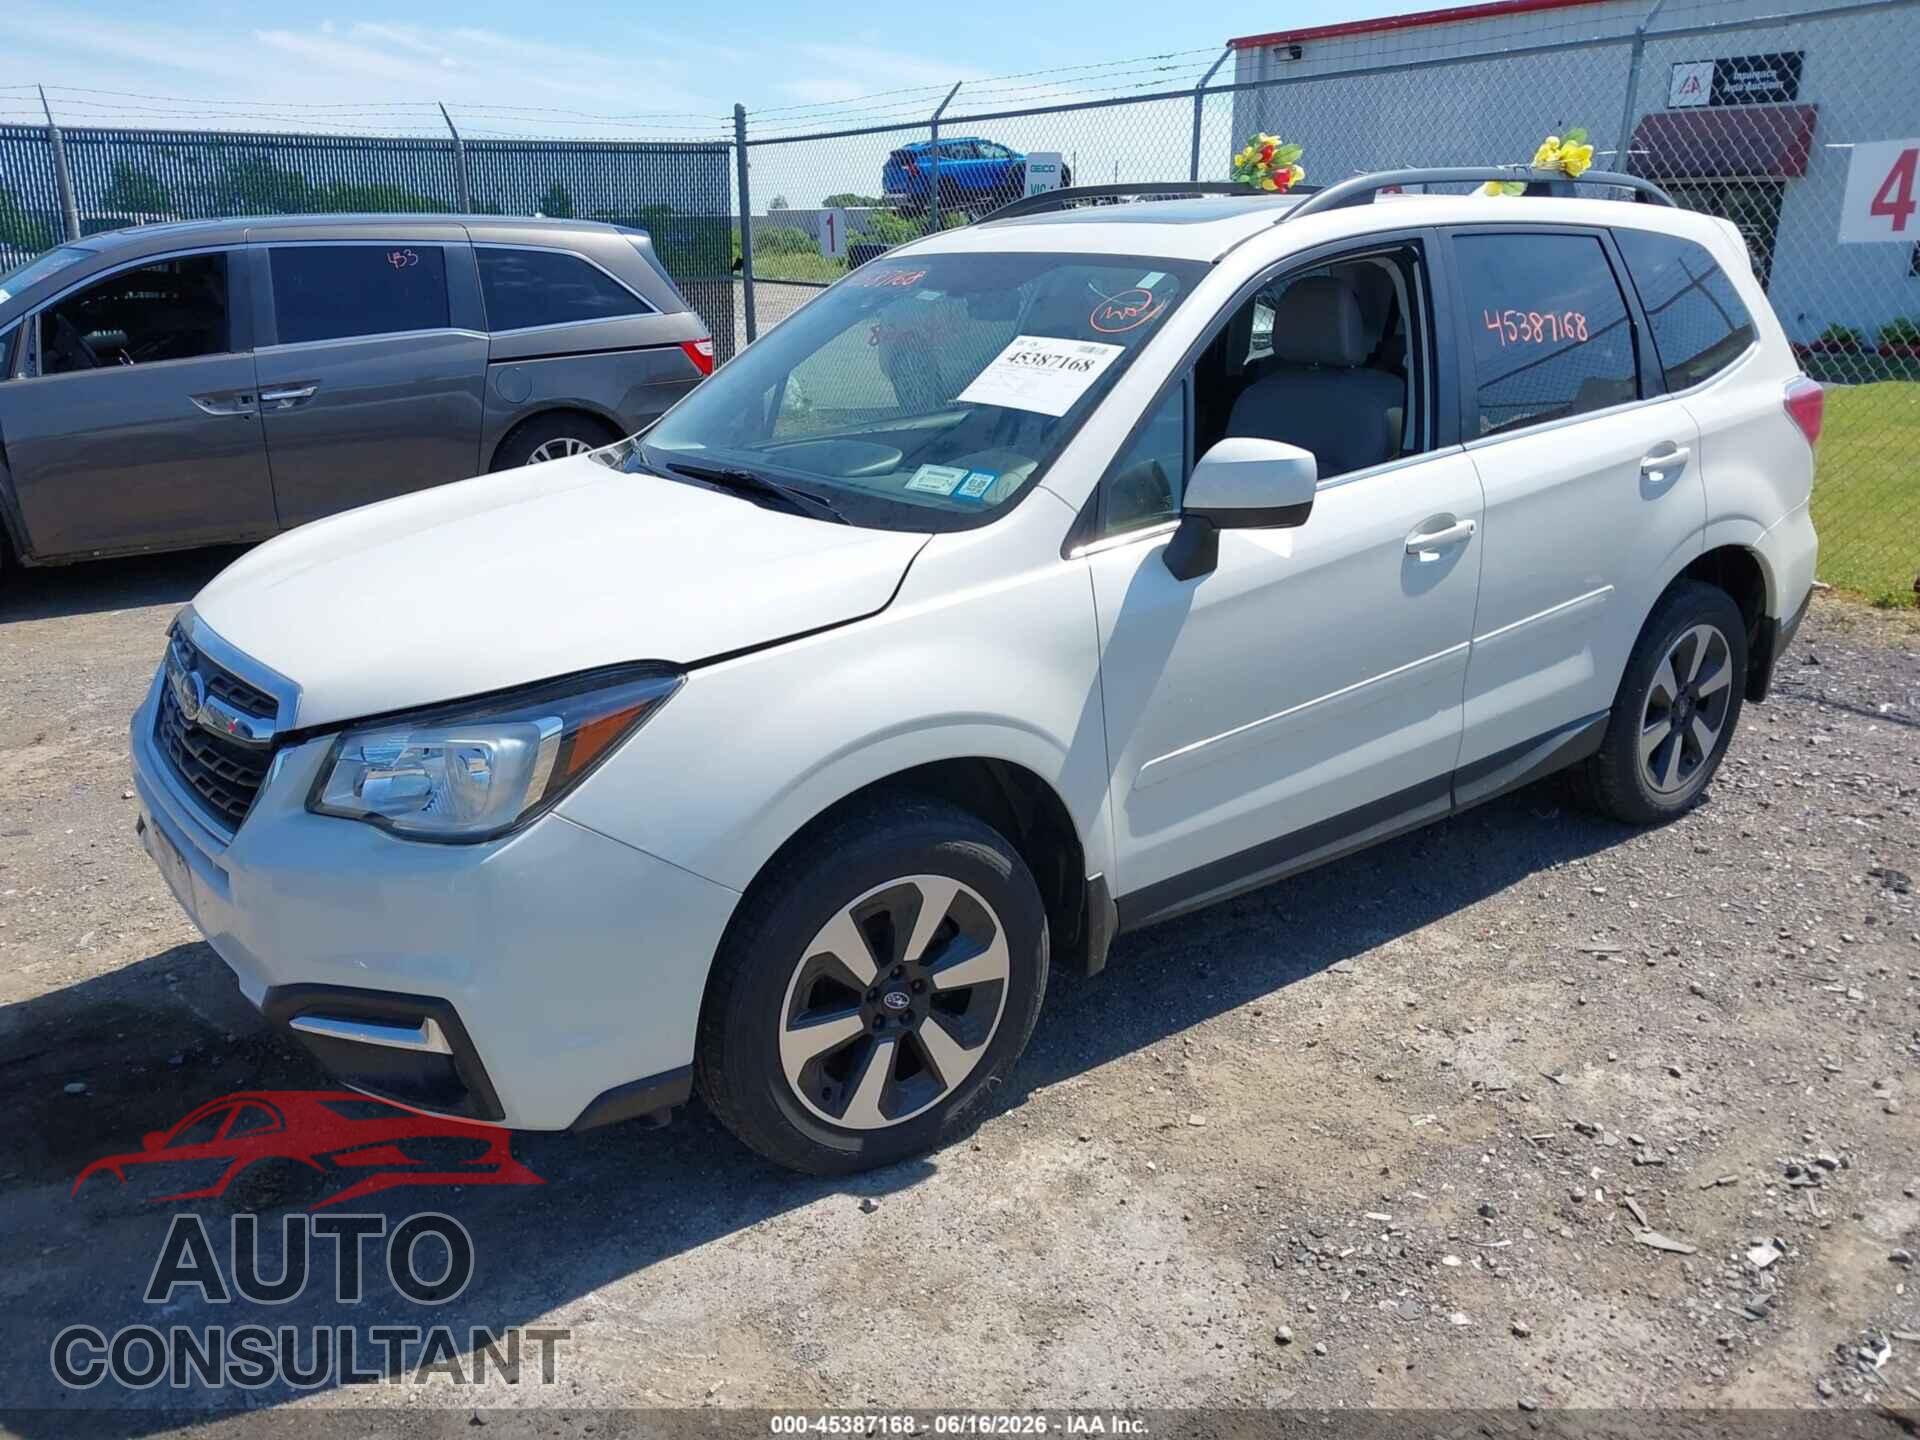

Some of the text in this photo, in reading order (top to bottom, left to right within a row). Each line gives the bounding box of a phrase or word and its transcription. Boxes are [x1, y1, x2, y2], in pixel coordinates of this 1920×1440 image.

[1030, 164, 1056, 173] GEICO
[1870, 148, 1919, 232] 4
[826, 212, 835, 252] 1
[1483, 309, 1588, 347] 45387168
[1007, 350, 1095, 373] 45387168
